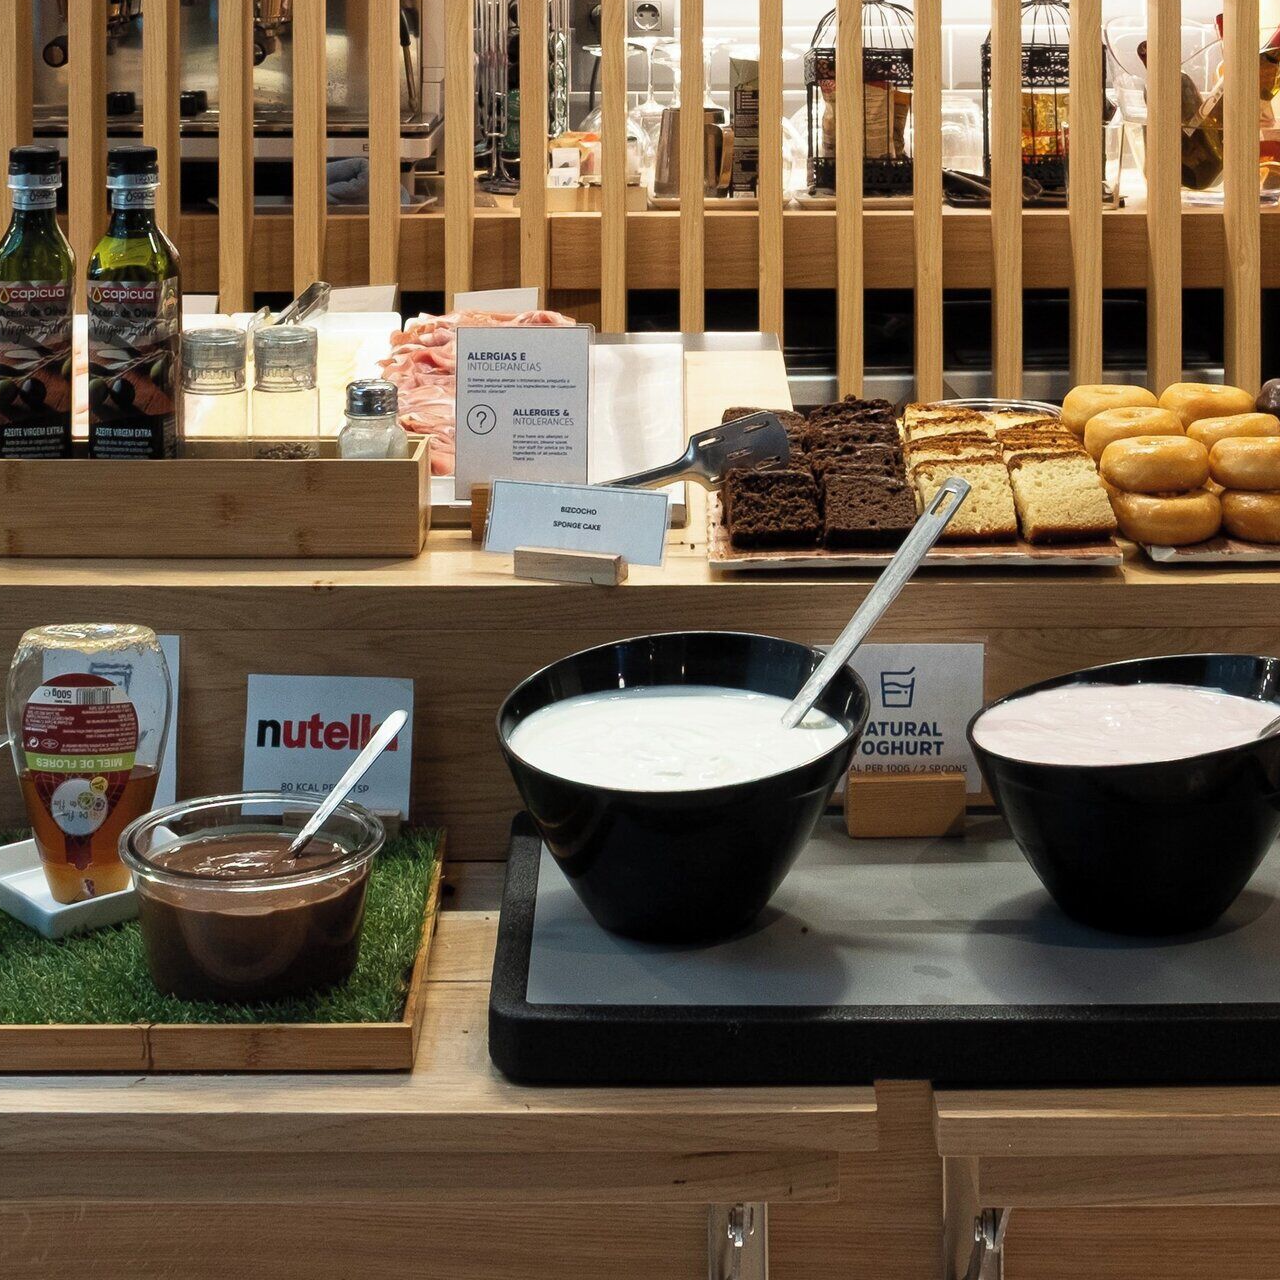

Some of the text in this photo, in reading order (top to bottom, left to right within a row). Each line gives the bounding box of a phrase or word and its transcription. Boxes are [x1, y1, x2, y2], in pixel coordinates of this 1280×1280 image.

[10, 287, 65, 302] capicua
[102, 287, 154, 303] capicua
[467, 352, 526, 360] ALERGIAS E
[467, 362, 541, 371] INTOLERANCIAS
[513, 417, 574, 426] INTOLERANCES
[135, 428, 152, 437] EXTRA
[561, 506, 597, 515] BIZCOCHO
[553, 521, 601, 531] SPONGE CAKE
[52, 688, 72, 699] 500g
[257, 713, 398, 752] nutell
[865, 721, 942, 736] ATURAL
[860, 741, 944, 755] OGHURT
[37, 757, 123, 768] MIEL DE FLORES
[850, 764, 861, 772] AL
[865, 764, 883, 772] PER
[887, 764, 910, 772] 100G
[929, 764, 968, 772] SPOONS
[281, 783, 293, 791] 80
[297, 782, 319, 791] KCAL
